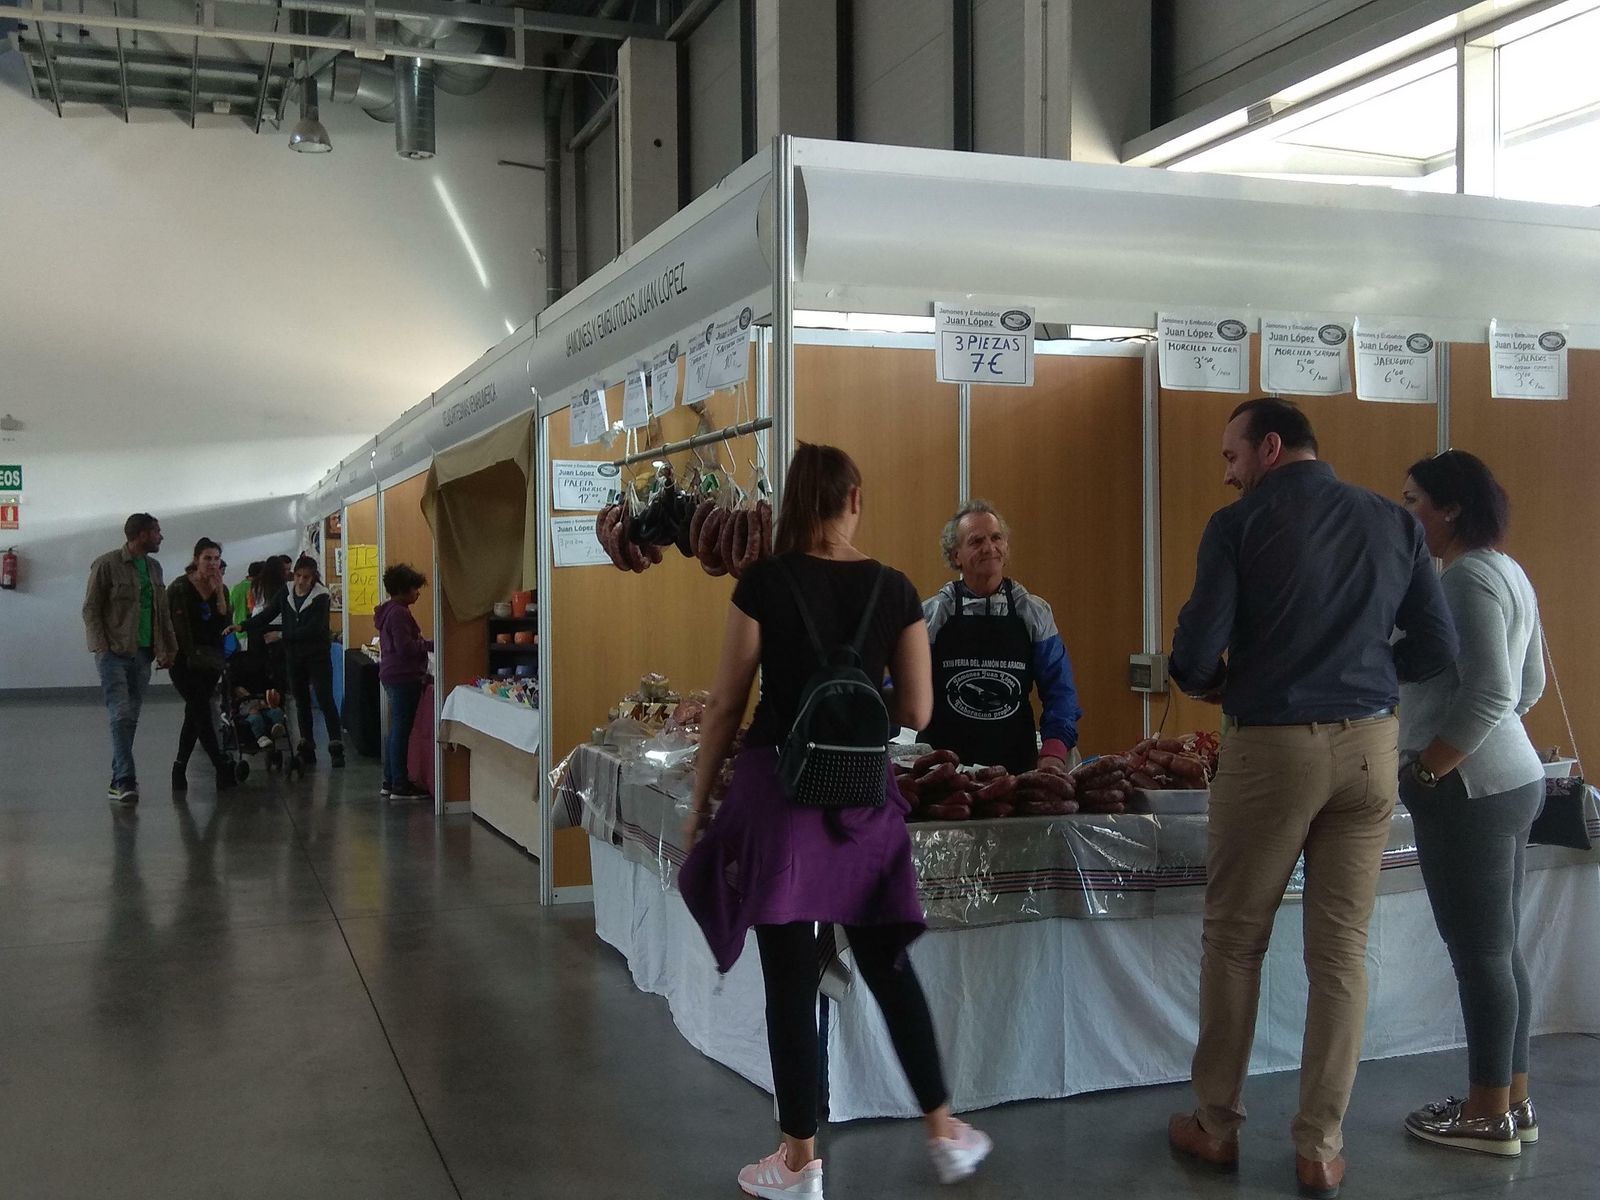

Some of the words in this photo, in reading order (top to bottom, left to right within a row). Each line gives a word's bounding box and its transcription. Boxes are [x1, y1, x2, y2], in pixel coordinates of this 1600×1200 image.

[566, 321, 593, 357] JAMONES
[597, 293, 637, 339] EMBUTIDOS
[637, 279, 659, 316] JUAN
[658, 262, 688, 304] LÓPEZ
[939, 308, 964, 316] Jamones
[970, 310, 1000, 318] Embutidos
[946, 316, 966, 325] Juan
[968, 317, 994, 328] López
[1165, 327, 1185, 337] Juan
[1188, 329, 1214, 340] López
[1269, 332, 1288, 342] Juan
[1291, 334, 1315, 344] López
[955, 335, 964, 351] 3
[967, 335, 1020, 352] PIEZAS
[1168, 342, 1207, 352] MORCILLA
[1212, 346, 1238, 354] NEGRA
[1359, 341, 1377, 350] Juan
[1379, 342, 1403, 352] López
[1495, 341, 1511, 349] Juan
[1513, 342, 1536, 351] López
[1274, 347, 1312, 356] MORCILLA
[576, 469, 594, 477] López
[574, 525, 594, 533] López
[954, 659, 969, 667] FERIA
[970, 659, 980, 667] DEL
[981, 658, 1000, 668] JAMÓN
[1000, 660, 1007, 669] DE
[981, 670, 999, 679] Juan
